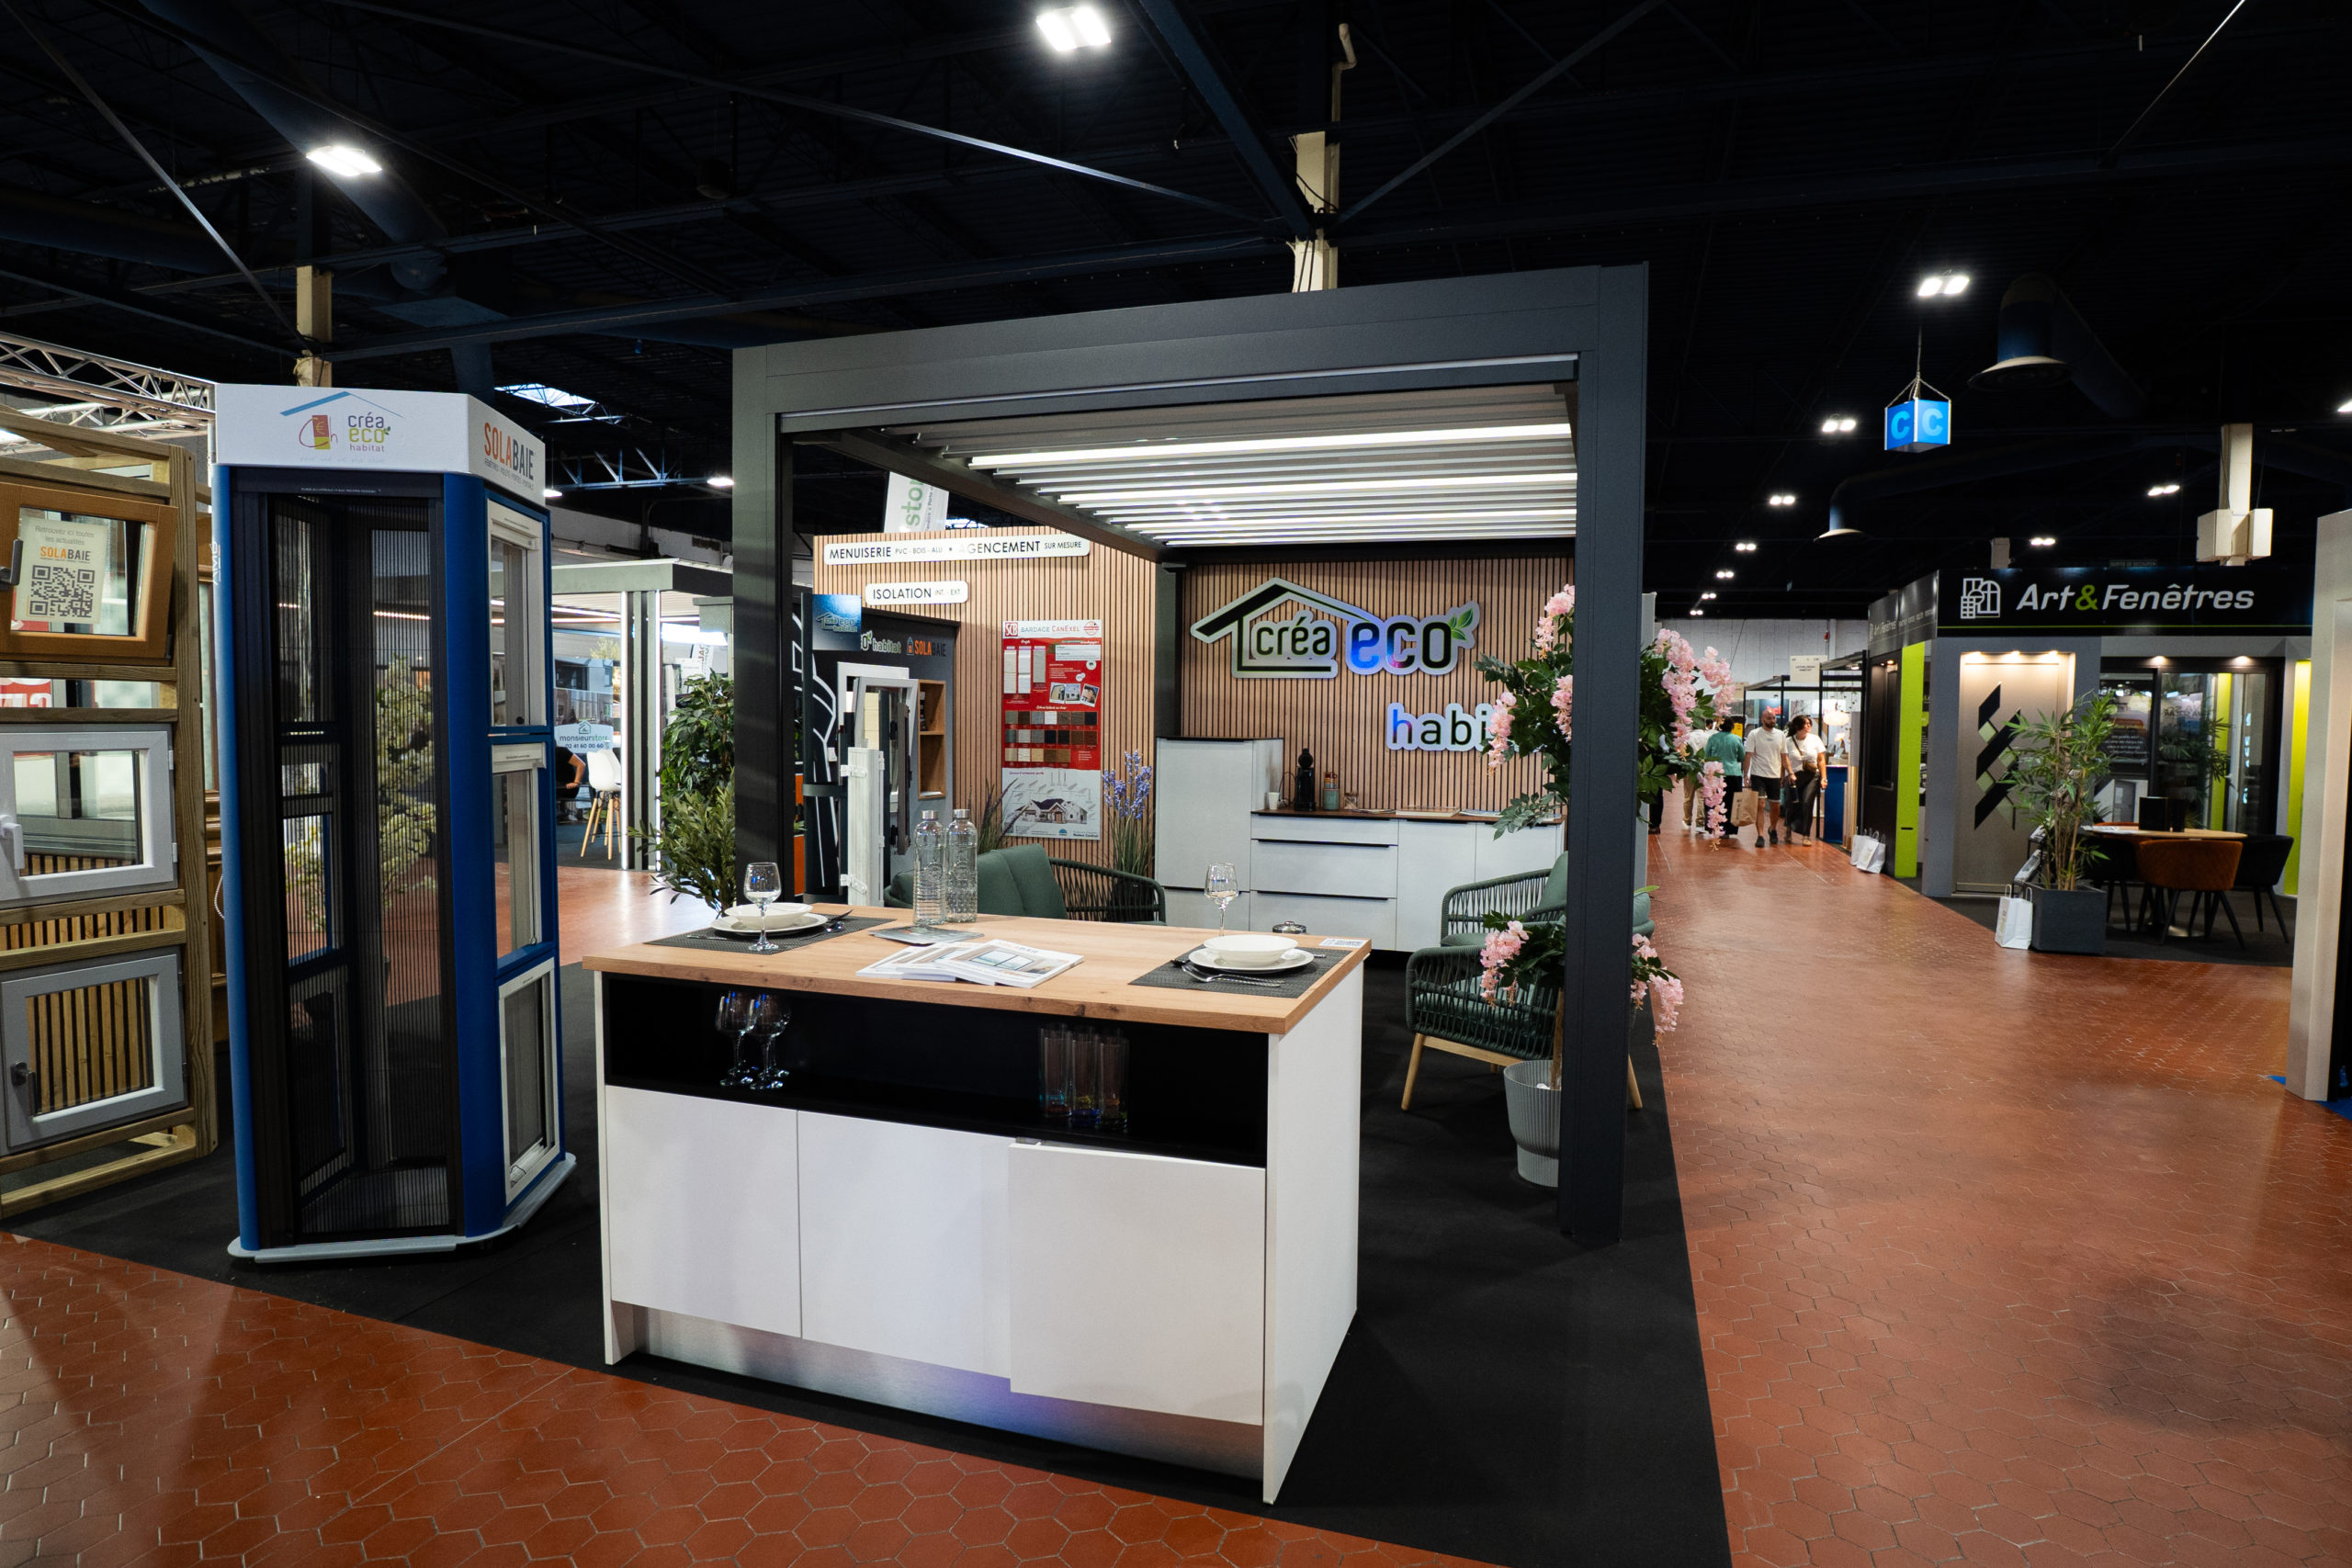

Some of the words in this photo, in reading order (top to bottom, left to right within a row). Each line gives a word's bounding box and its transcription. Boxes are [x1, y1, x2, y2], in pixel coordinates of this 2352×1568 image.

[348, 412, 384, 428] créa
[1891, 411, 1910, 440] C
[1922, 408, 1943, 436] C
[348, 428, 385, 443] eco
[350, 443, 385, 452] habitat
[484, 422, 534, 480] SOLABAIE
[35, 525, 67, 535] Retrouvez
[40, 546, 91, 561] SOLABAIE
[830, 547, 891, 559] MENUISERIE
[959, 541, 1040, 554] GENCEMENT
[873, 588, 932, 600] ISOLATION
[2016, 583, 2255, 611] Art&Fenêtres
[1005, 623, 1018, 637] SCB
[873, 637, 902, 653] habitat
[914, 640, 946, 657] SOLABAIE
[1255, 615, 1330, 656] créa
[1351, 621, 1453, 668] eco
